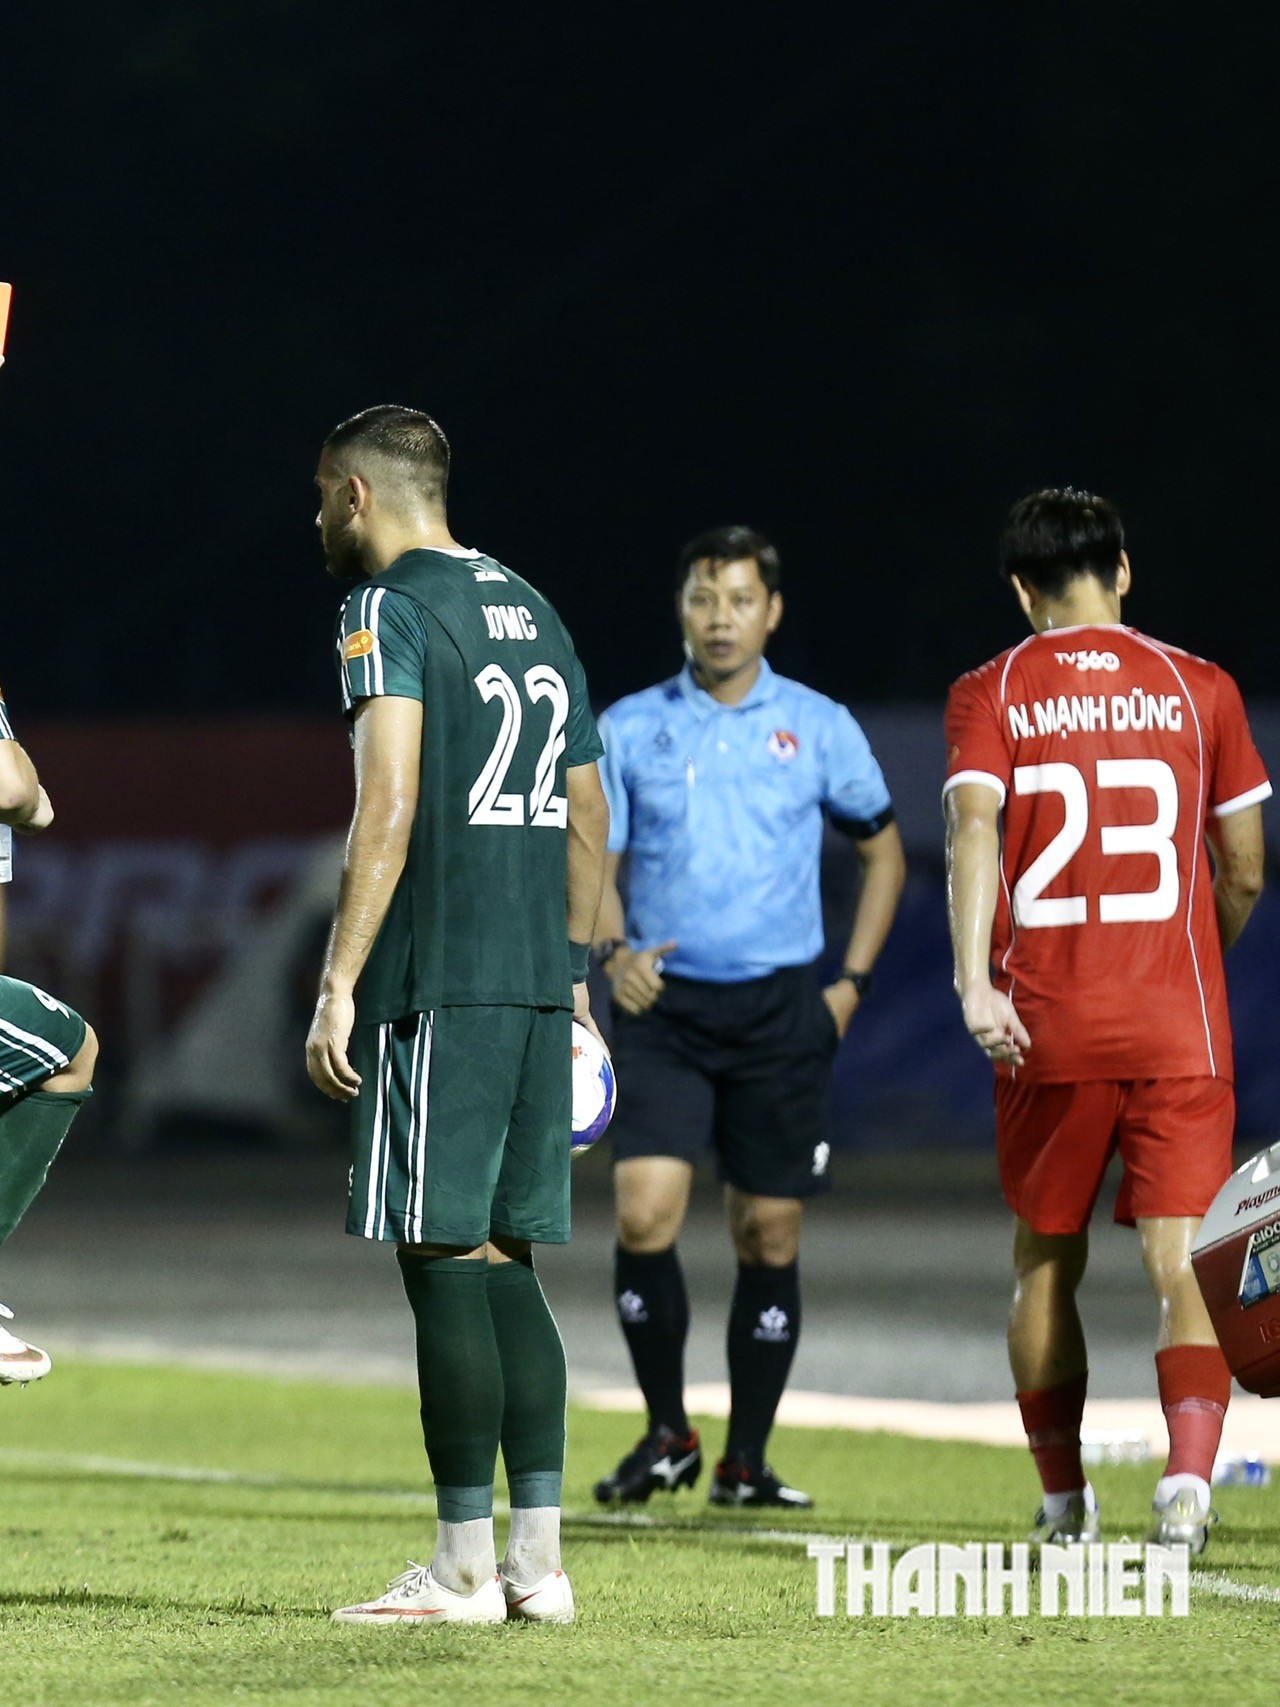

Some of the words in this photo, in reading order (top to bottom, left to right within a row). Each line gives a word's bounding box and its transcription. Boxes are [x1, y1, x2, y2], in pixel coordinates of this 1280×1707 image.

[1008, 695, 1108, 740] N.MẠNH
[1111, 687, 1182, 732] DŨNG
[1054, 650, 1121, 672] TV360
[468, 663, 569, 829] 22
[1012, 758, 1180, 929] 23
